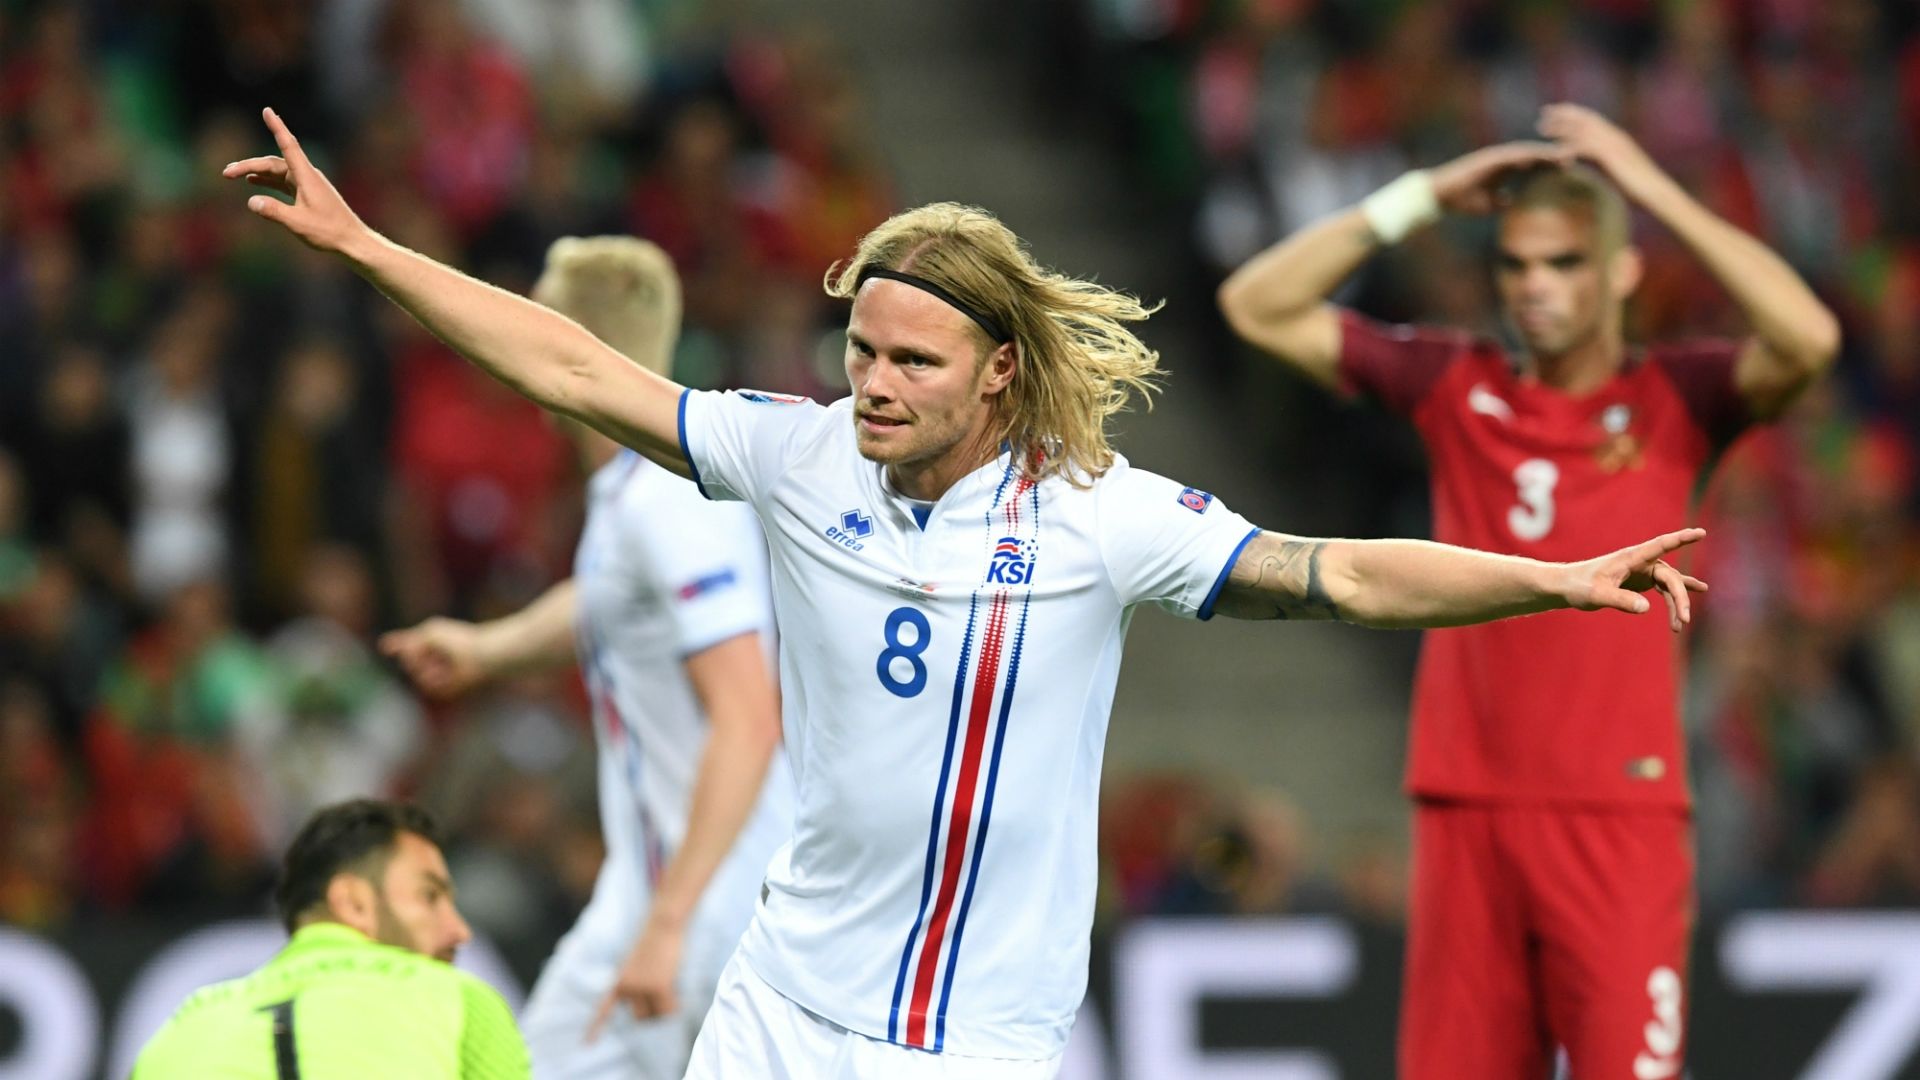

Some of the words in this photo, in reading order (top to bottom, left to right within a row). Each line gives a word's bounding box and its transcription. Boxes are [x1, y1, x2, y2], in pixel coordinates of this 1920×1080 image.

[1507, 458, 1559, 543] 3
[876, 606, 932, 698] 8
[1645, 966, 1683, 1058] 3
